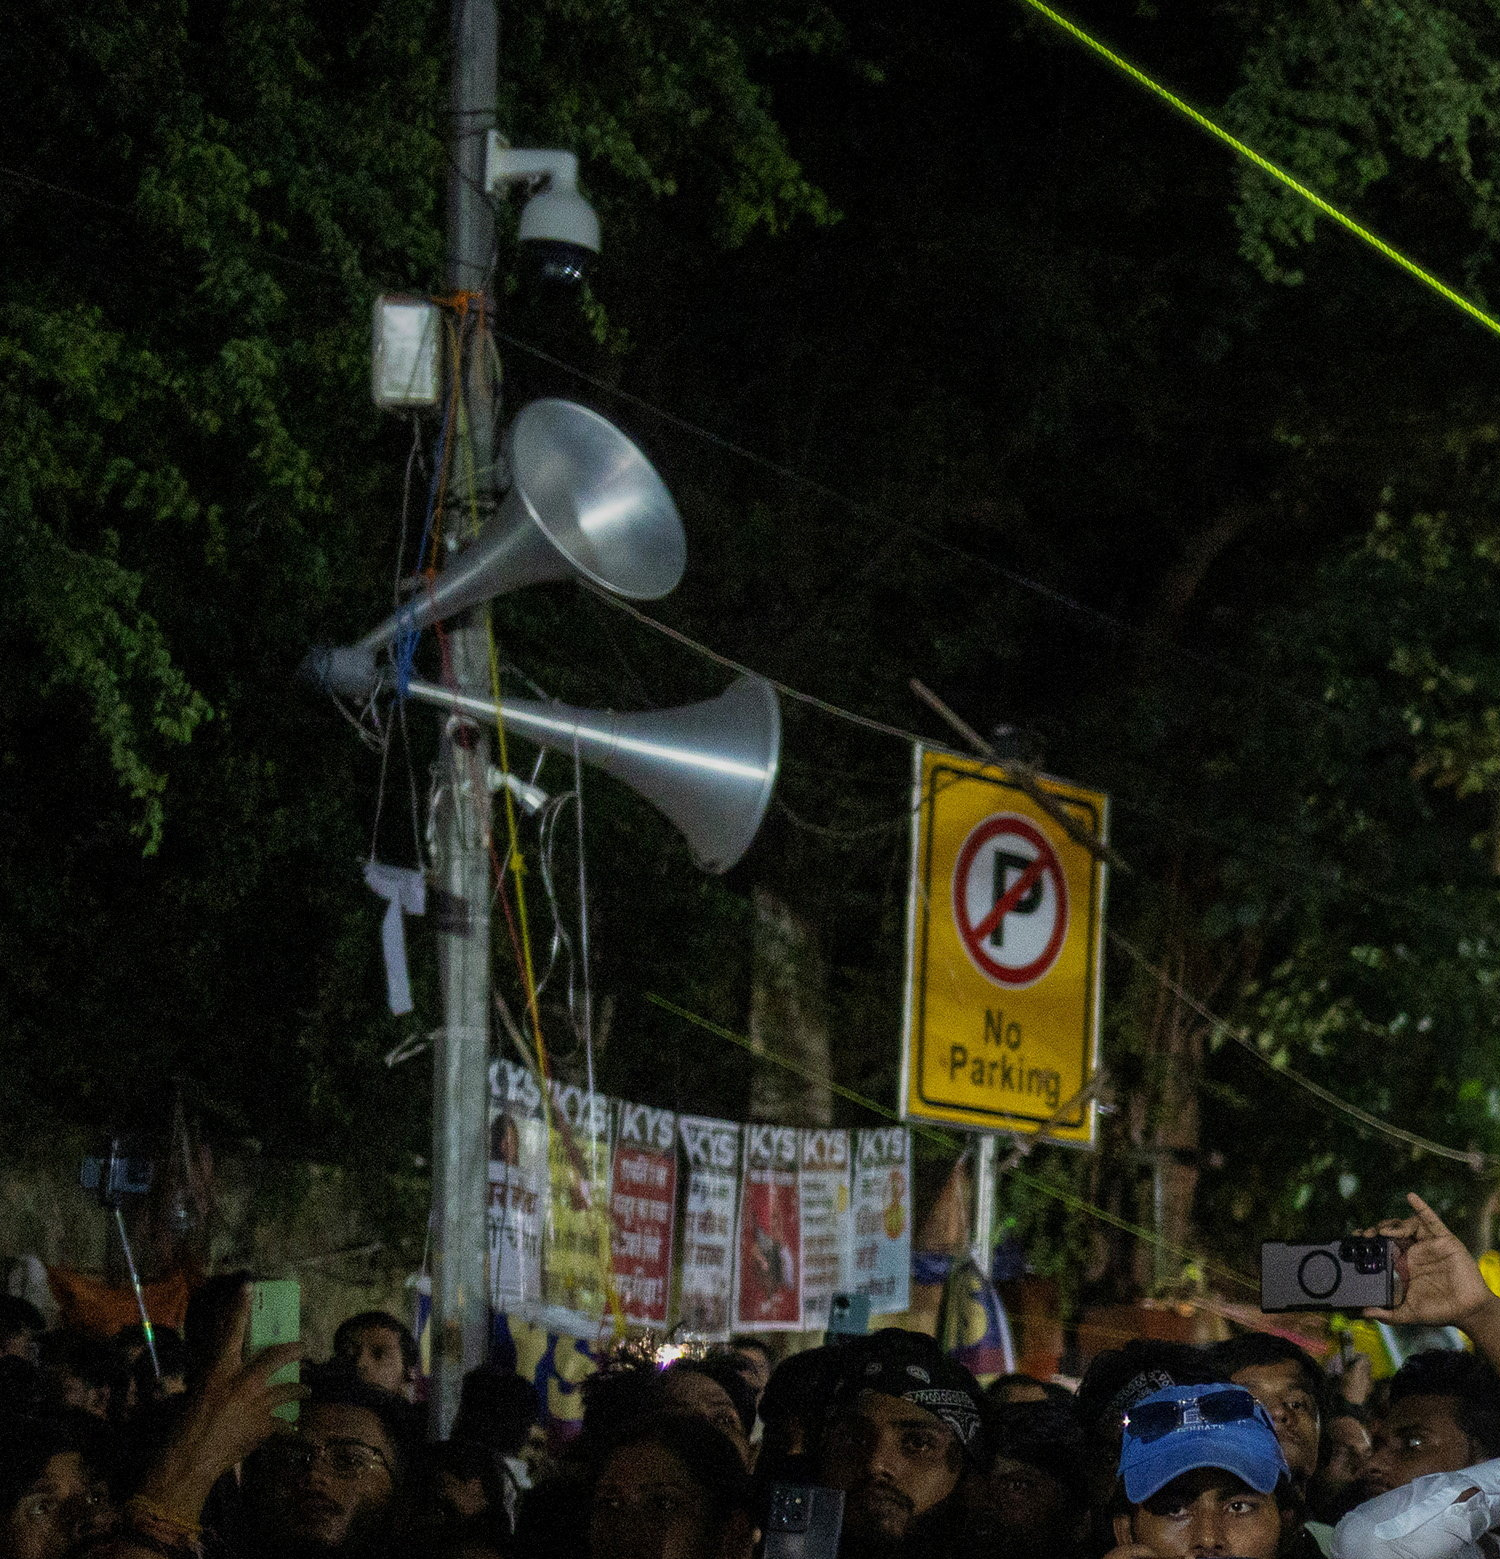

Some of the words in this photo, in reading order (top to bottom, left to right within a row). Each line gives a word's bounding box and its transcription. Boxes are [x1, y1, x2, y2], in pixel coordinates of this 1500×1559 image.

[983, 1008, 1022, 1049] No
[949, 1045, 1061, 1109] Parking
[621, 1102, 674, 1148] KYS
[686, 1124, 737, 1166] KYS
[749, 1123, 797, 1160] KYS
[803, 1128, 848, 1163] KYS
[861, 1127, 903, 1160] KYS
